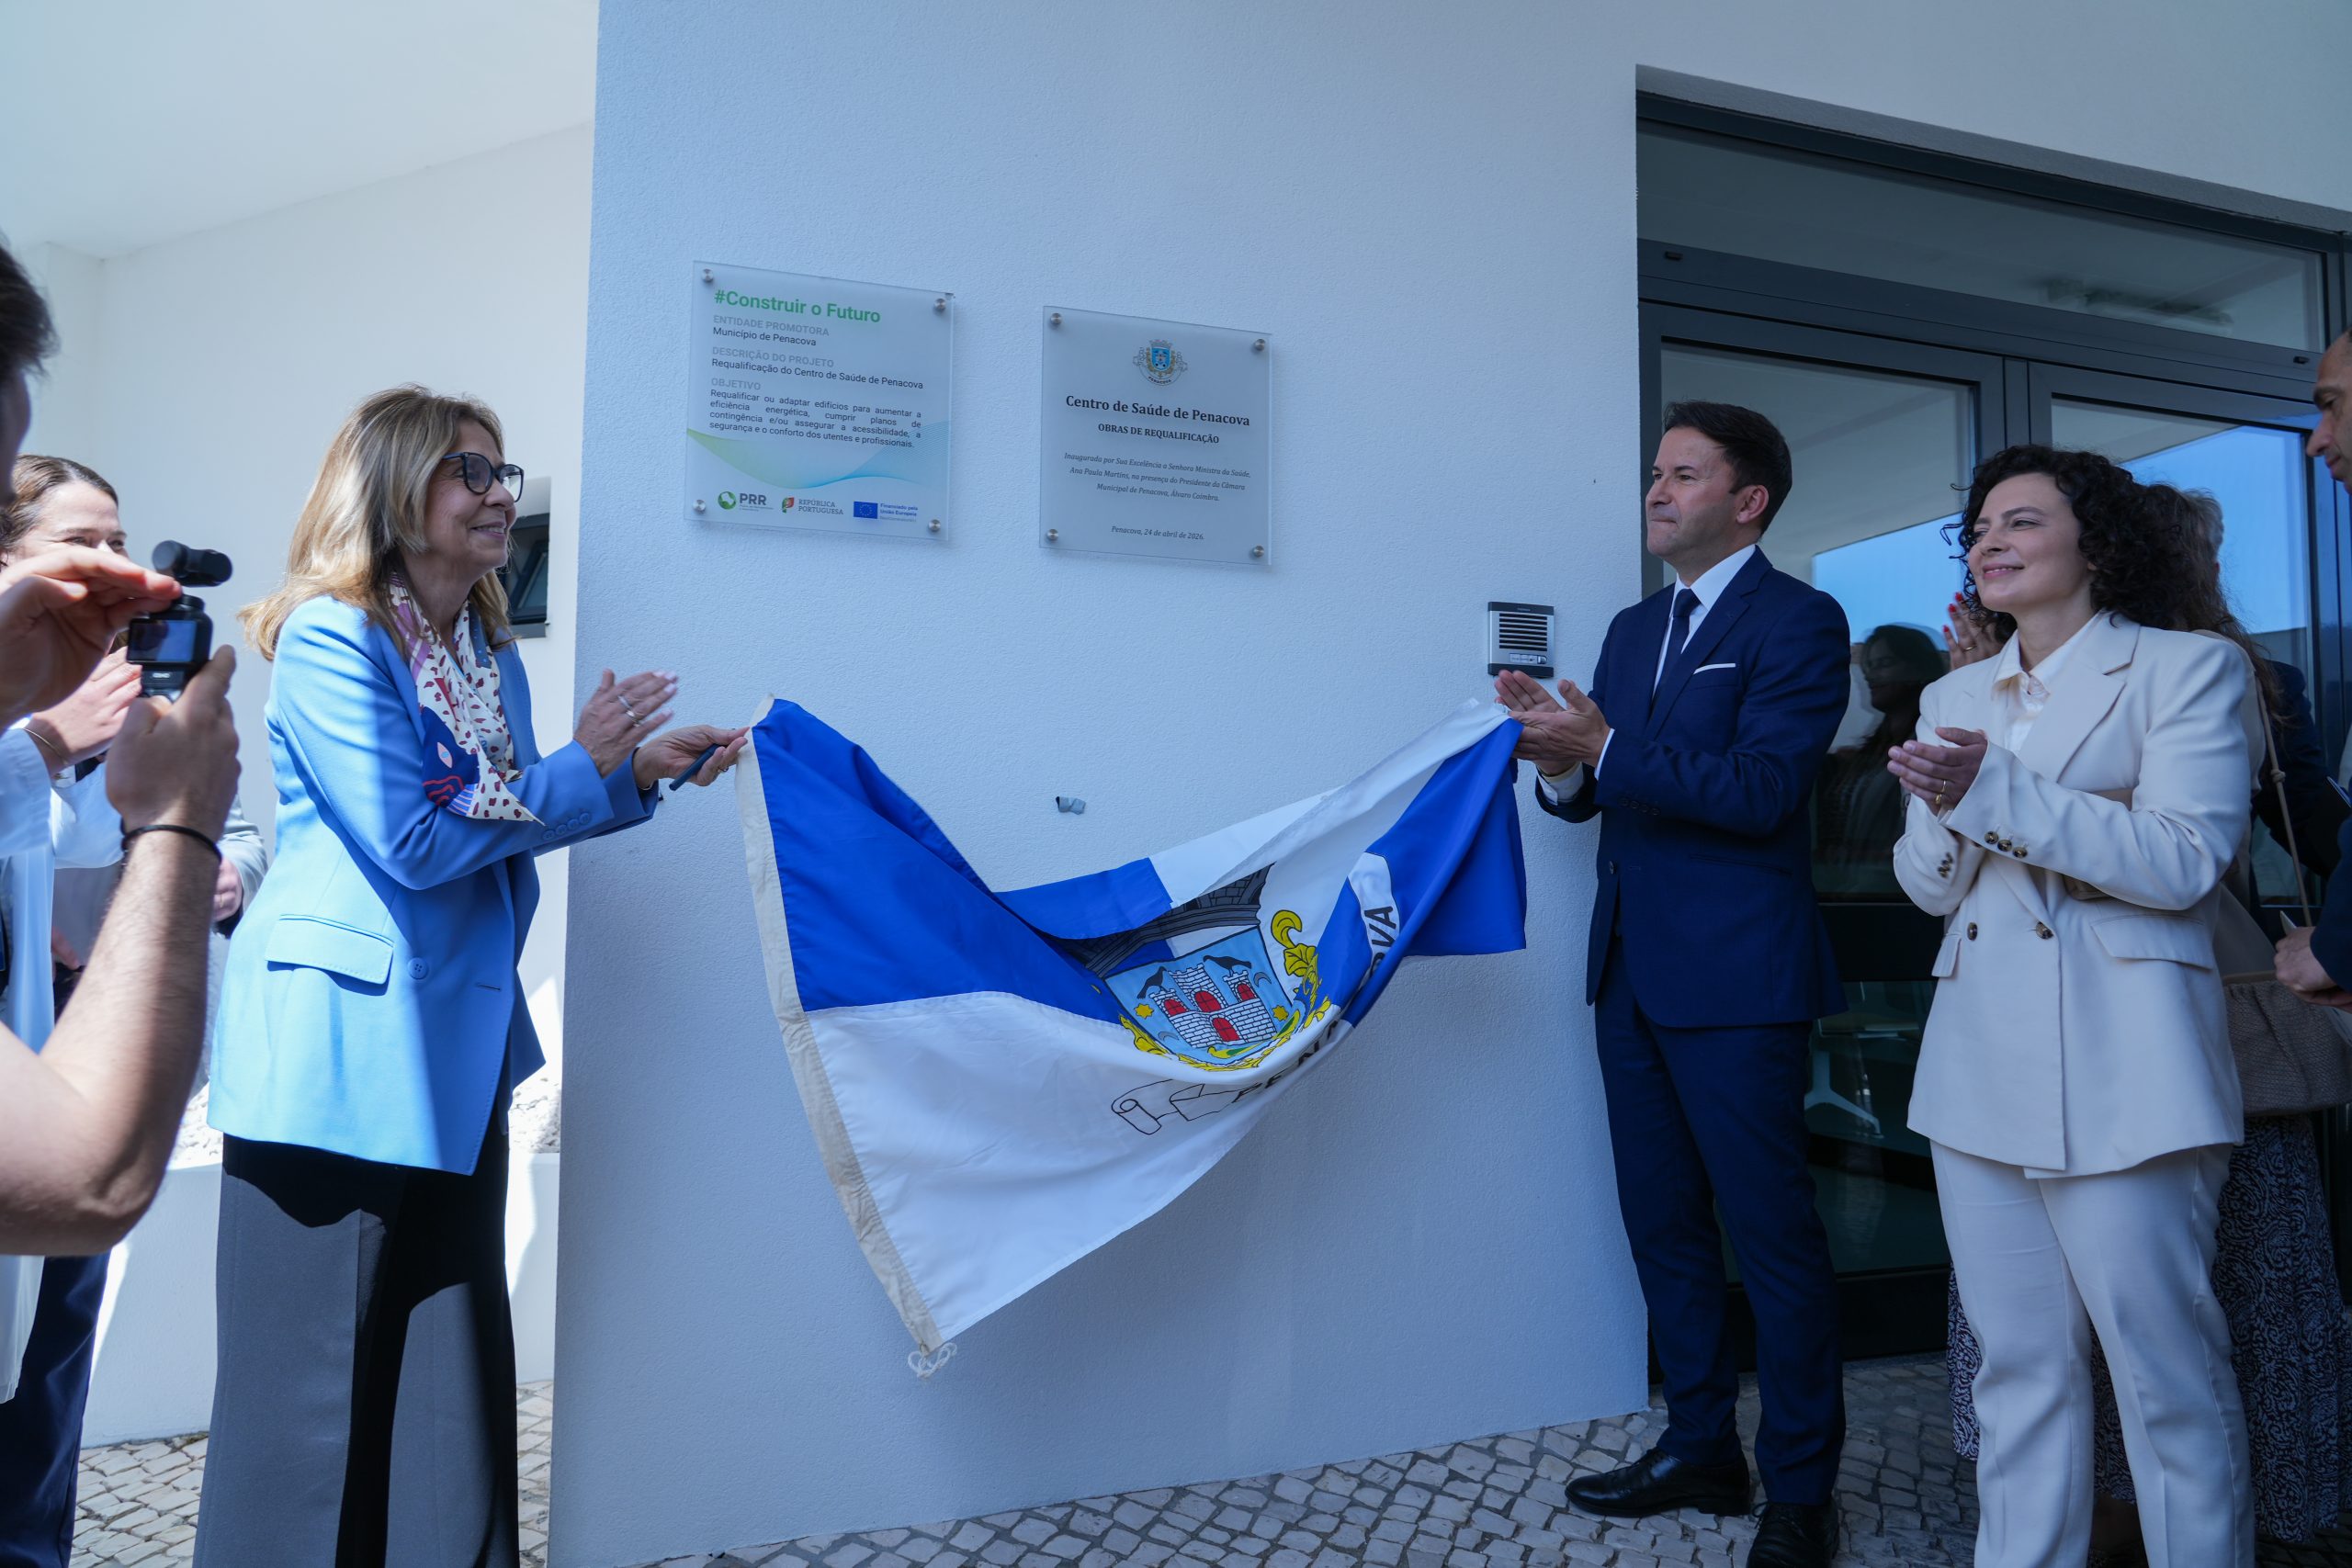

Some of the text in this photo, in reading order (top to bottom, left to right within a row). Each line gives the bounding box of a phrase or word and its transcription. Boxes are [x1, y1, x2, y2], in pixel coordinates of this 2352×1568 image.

[714, 290, 881, 322] #Construir o Futuro
[713, 314, 830, 336] ENTIDADE PROMOTORA
[713, 327, 817, 346] Município de Penacova
[712, 346, 834, 368] DESCRIÇÃO DO PROJETO
[711, 358, 923, 389] Requalificação do Centro de Saúde de Penacova
[711, 378, 762, 390] OBJETIVO
[710, 389, 760, 401] Requalificar
[778, 397, 811, 409] adaptar
[853, 405, 871, 413] para
[875, 408, 912, 417] aumentar
[710, 400, 750, 411] eficiência
[765, 407, 810, 418] energética,
[825, 412, 856, 422] cumprir
[870, 417, 897, 426] planos
[1066, 395, 1250, 425] Centro de Saúde de Penacova
[709, 412, 763, 423] contingência
[769, 417, 788, 425] e/ou
[795, 421, 835, 430] assegurar
[853, 425, 910, 438] acessibilidade,
[709, 422, 752, 434] segurança
[769, 427, 806, 437] conforto
[806, 431, 821, 439] dos
[823, 434, 854, 442] utentes
[862, 437, 915, 448] profissionais.
[1098, 423, 1220, 444] OBRAS DE REQUALIFICAÇÃO
[1064, 452, 1102, 462] Inaugurada
[1115, 457, 1128, 466] Sua
[1128, 458, 1162, 468] Excelência
[1168, 463, 1194, 472] Senhora
[1195, 466, 1221, 475] Ministra
[1230, 469, 1251, 478] Saúde,
[1069, 467, 1083, 475] Ana
[1084, 468, 1102, 477] Paula
[1103, 469, 1130, 479] Martins,
[1140, 475, 1169, 484] presença
[1170, 476, 1178, 484] do
[1179, 477, 1211, 487] Presidente
[1221, 481, 1245, 491] Câmara
[740, 492, 767, 506] PRR
[798, 498, 836, 508] REPÚBLICA
[1097, 483, 1128, 493] Municipal
[1138, 487, 1170, 497] Penacova,
[1170, 489, 1192, 499] Álvaro
[1192, 492, 1220, 502] Coimbra.
[797, 505, 844, 515] PORTUGUESA
[1111, 525, 1143, 536] Penacova,
[1162, 530, 1178, 538] abril
[1187, 532, 1204, 540] 2026.
